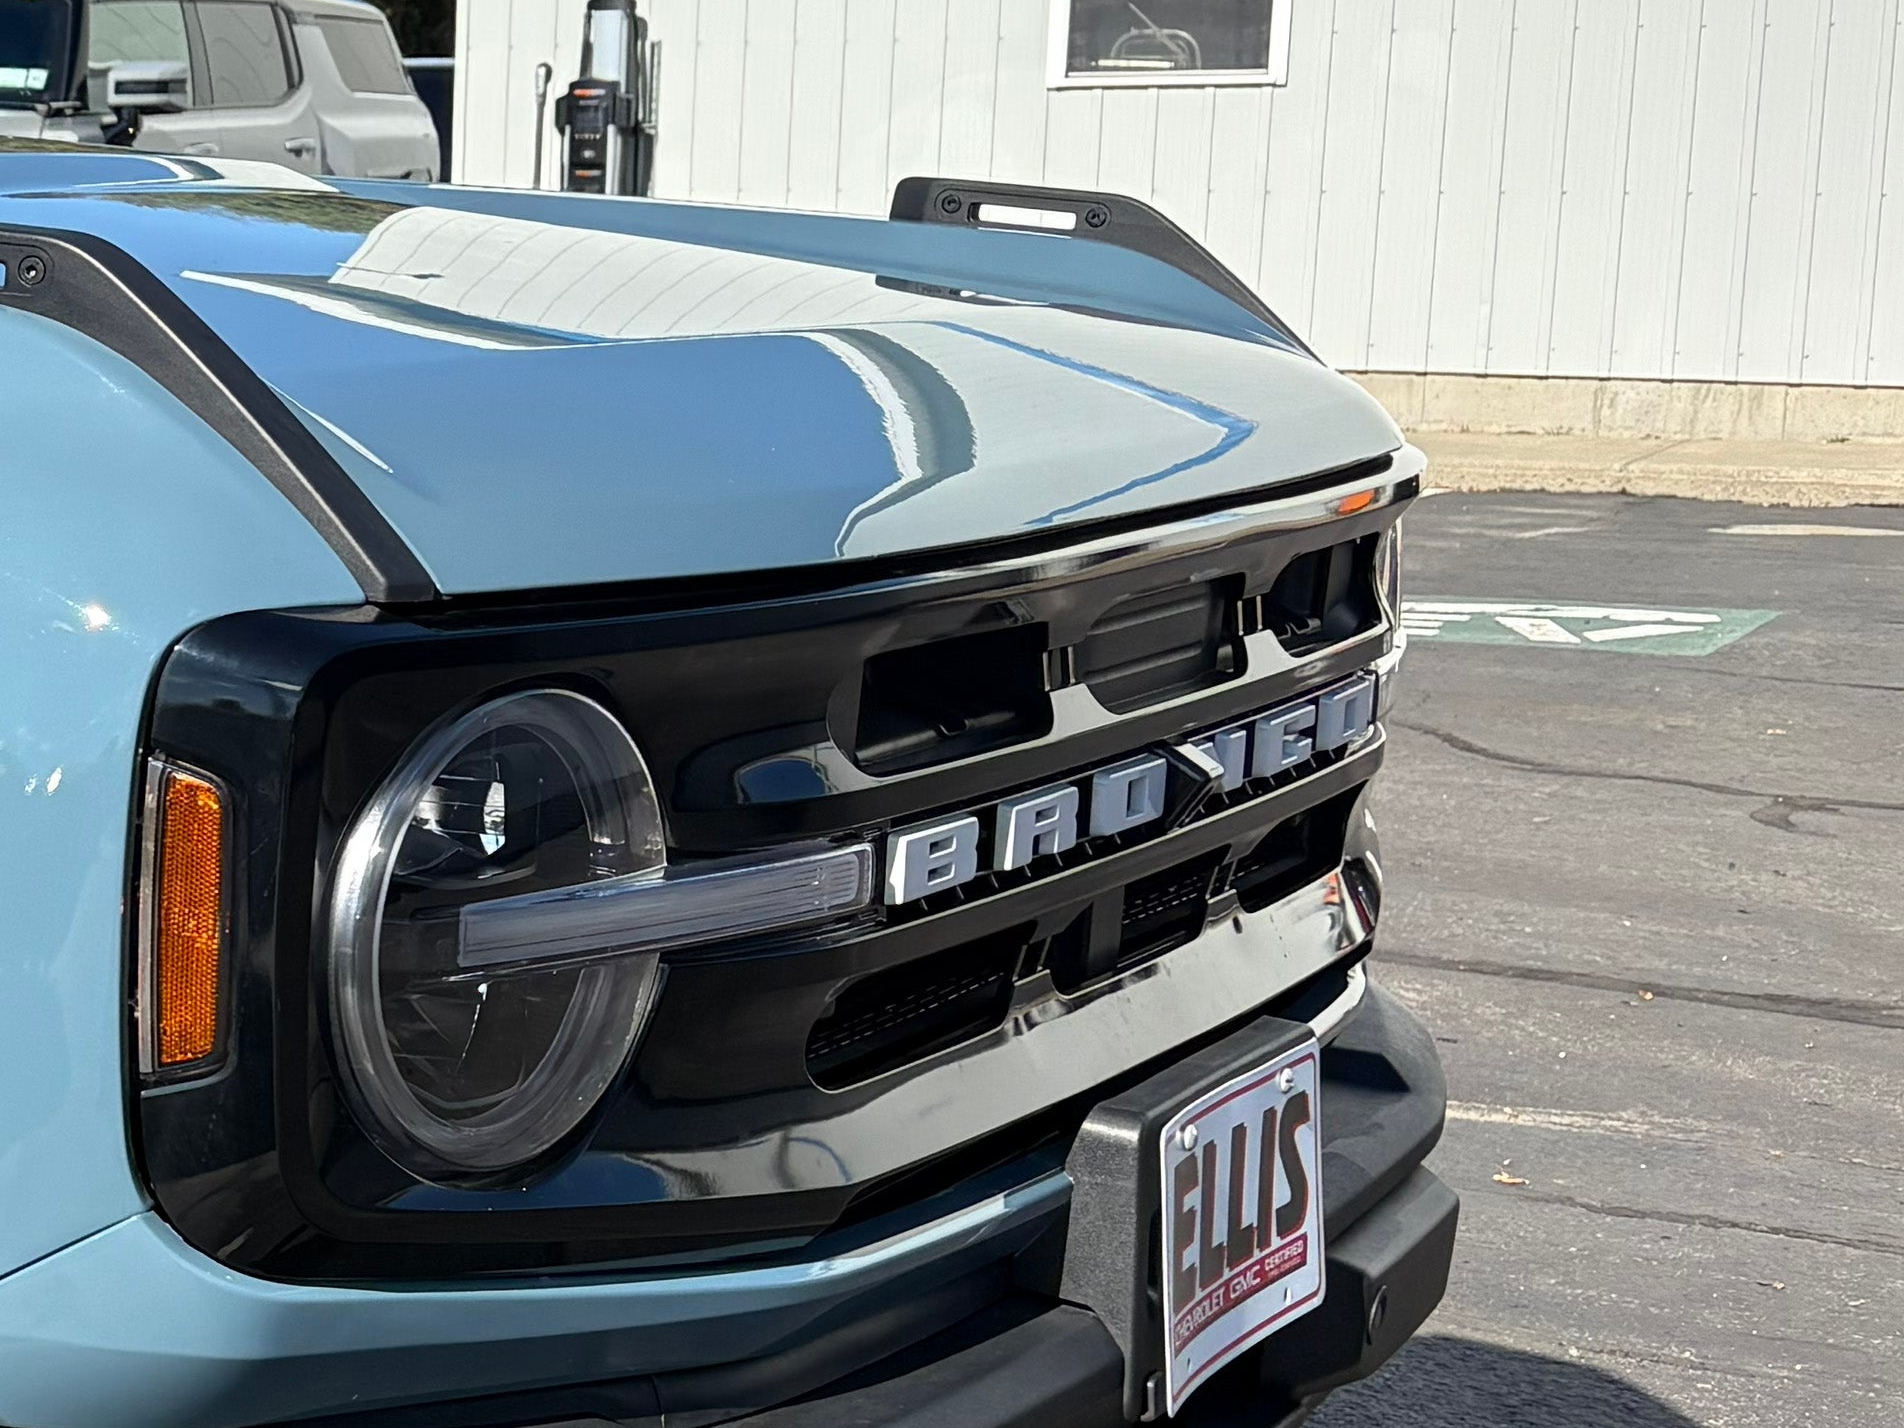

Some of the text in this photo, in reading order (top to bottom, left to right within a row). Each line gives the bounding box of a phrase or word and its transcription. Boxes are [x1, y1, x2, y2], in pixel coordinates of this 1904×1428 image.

[884, 670, 1375, 906] BRONCO
[1173, 1089, 1311, 1318] ELLIS
[1229, 1264, 1262, 1299] GMC
